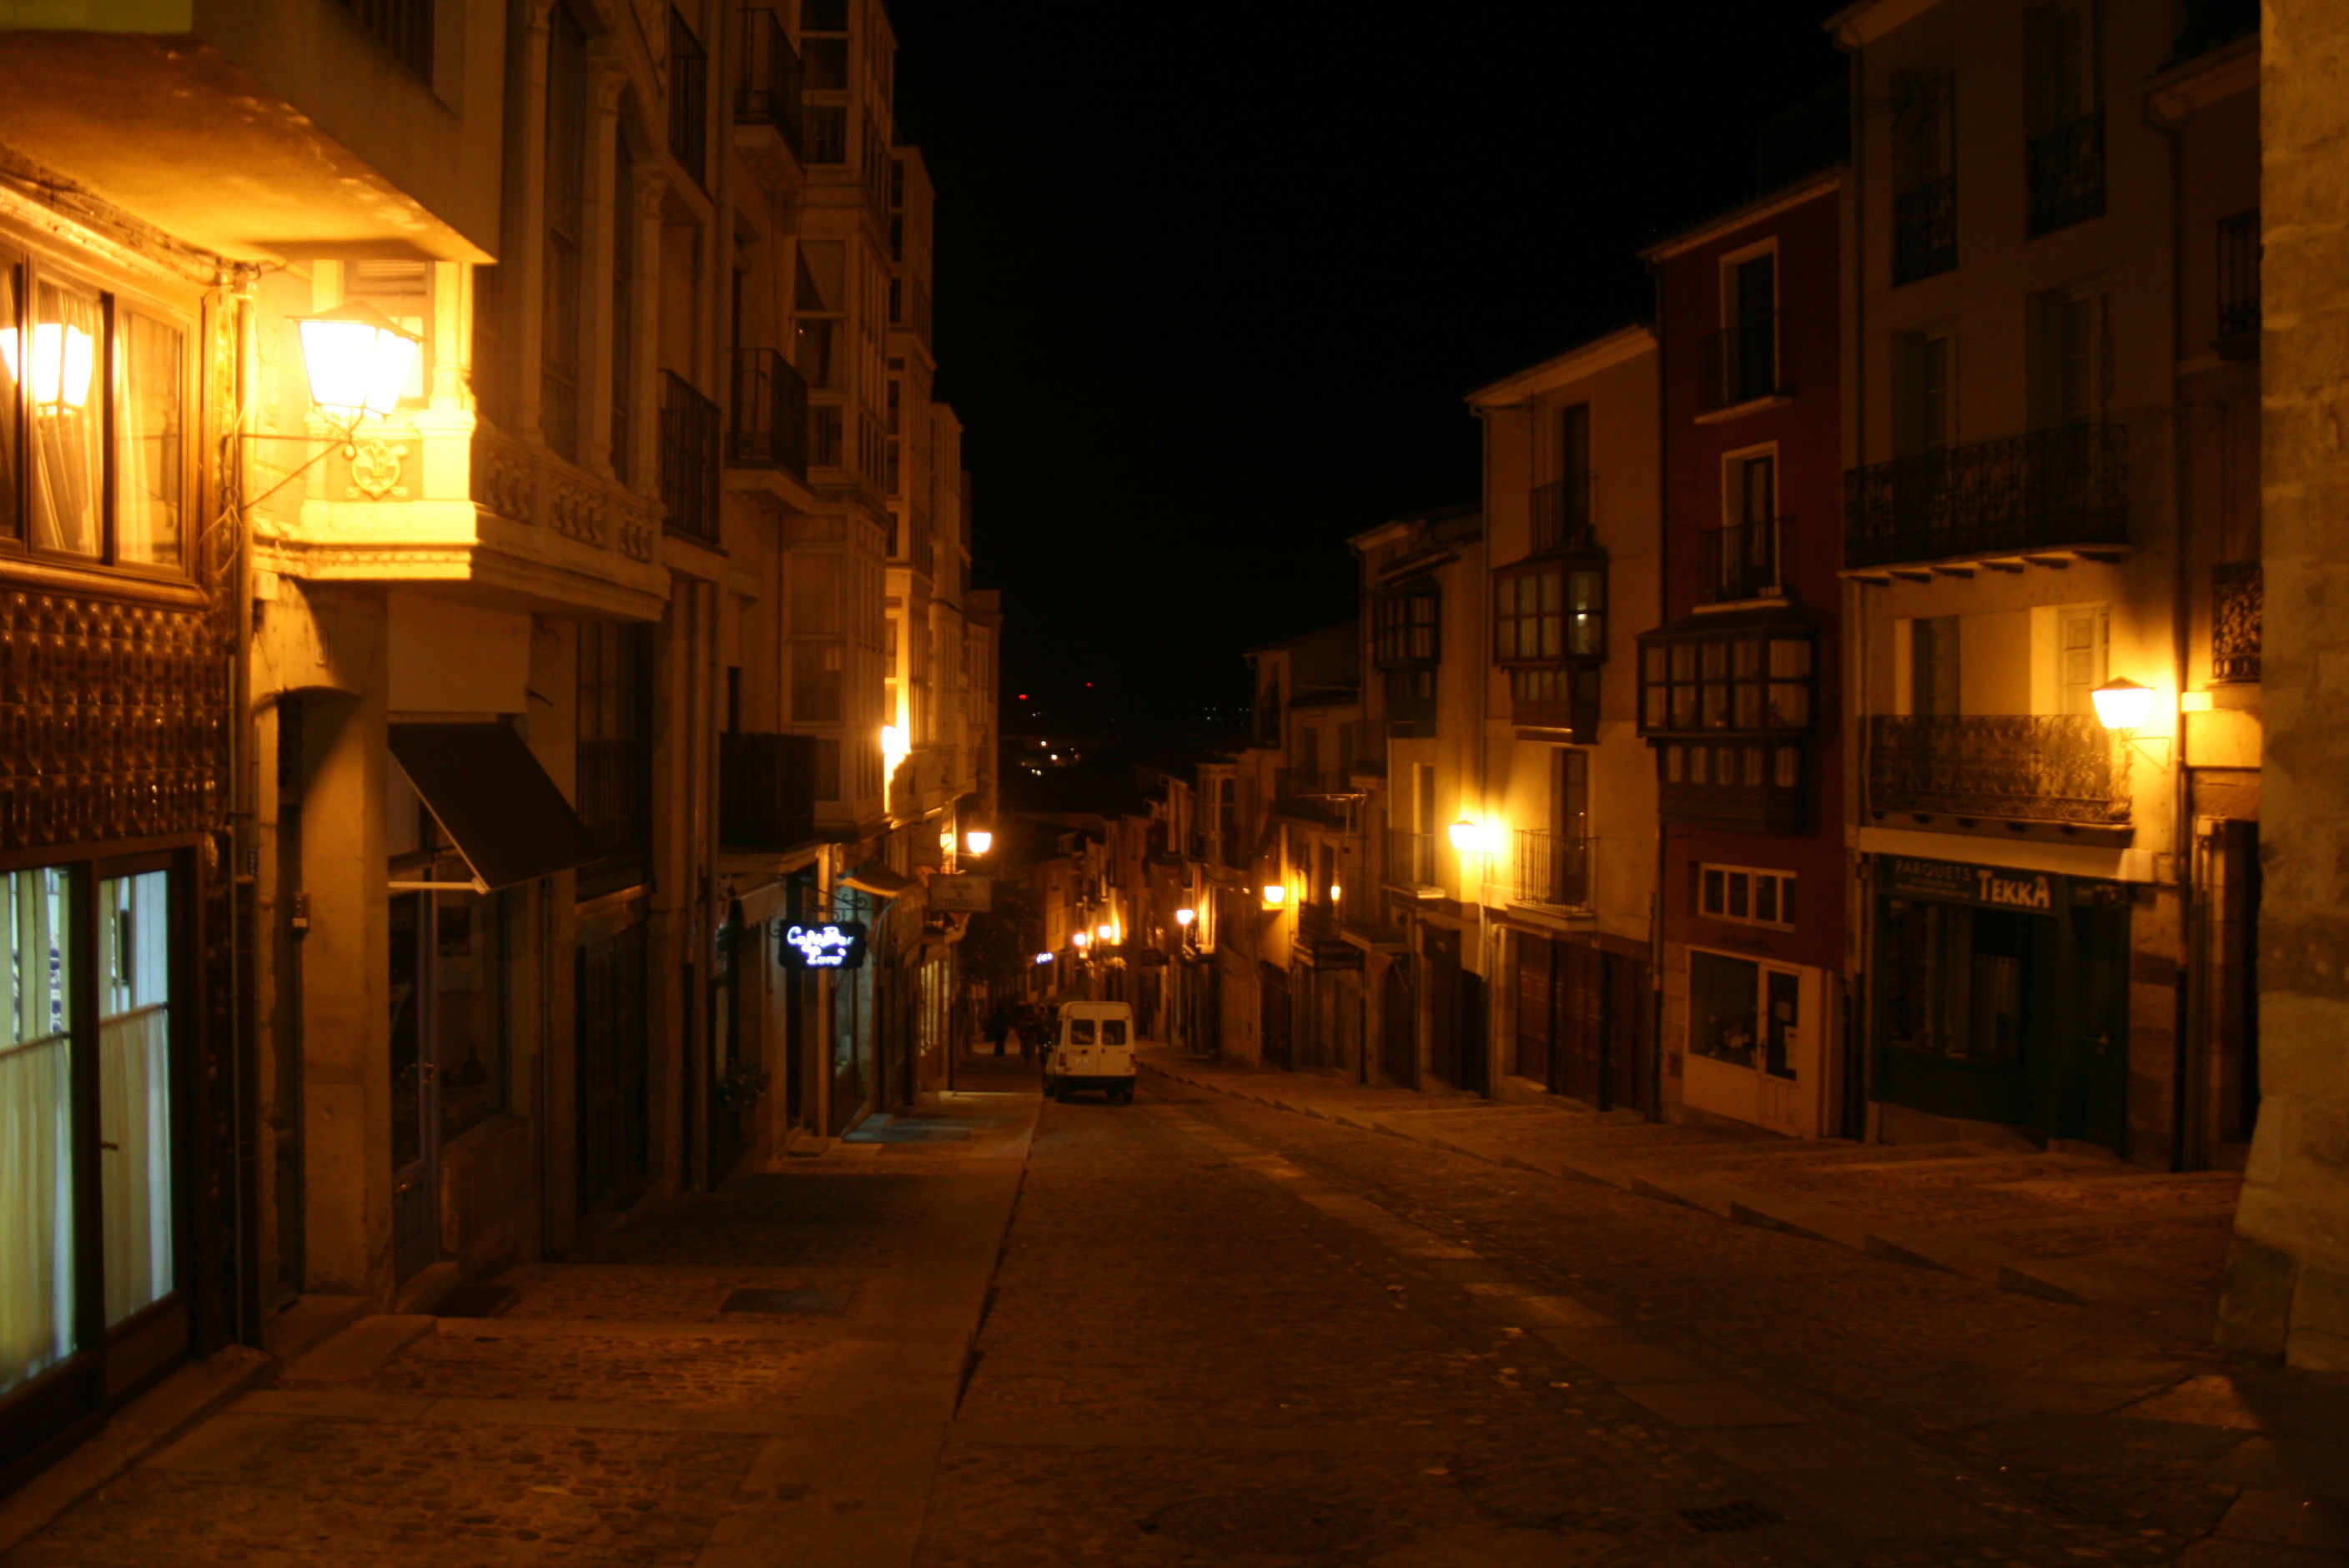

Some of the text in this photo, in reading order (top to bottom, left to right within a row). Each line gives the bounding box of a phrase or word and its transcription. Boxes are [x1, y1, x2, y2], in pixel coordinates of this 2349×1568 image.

[1895, 859, 1971, 882] PARQUETS
[1976, 869, 2050, 909] TEKKA
[819, 926, 853, 947] Bar
